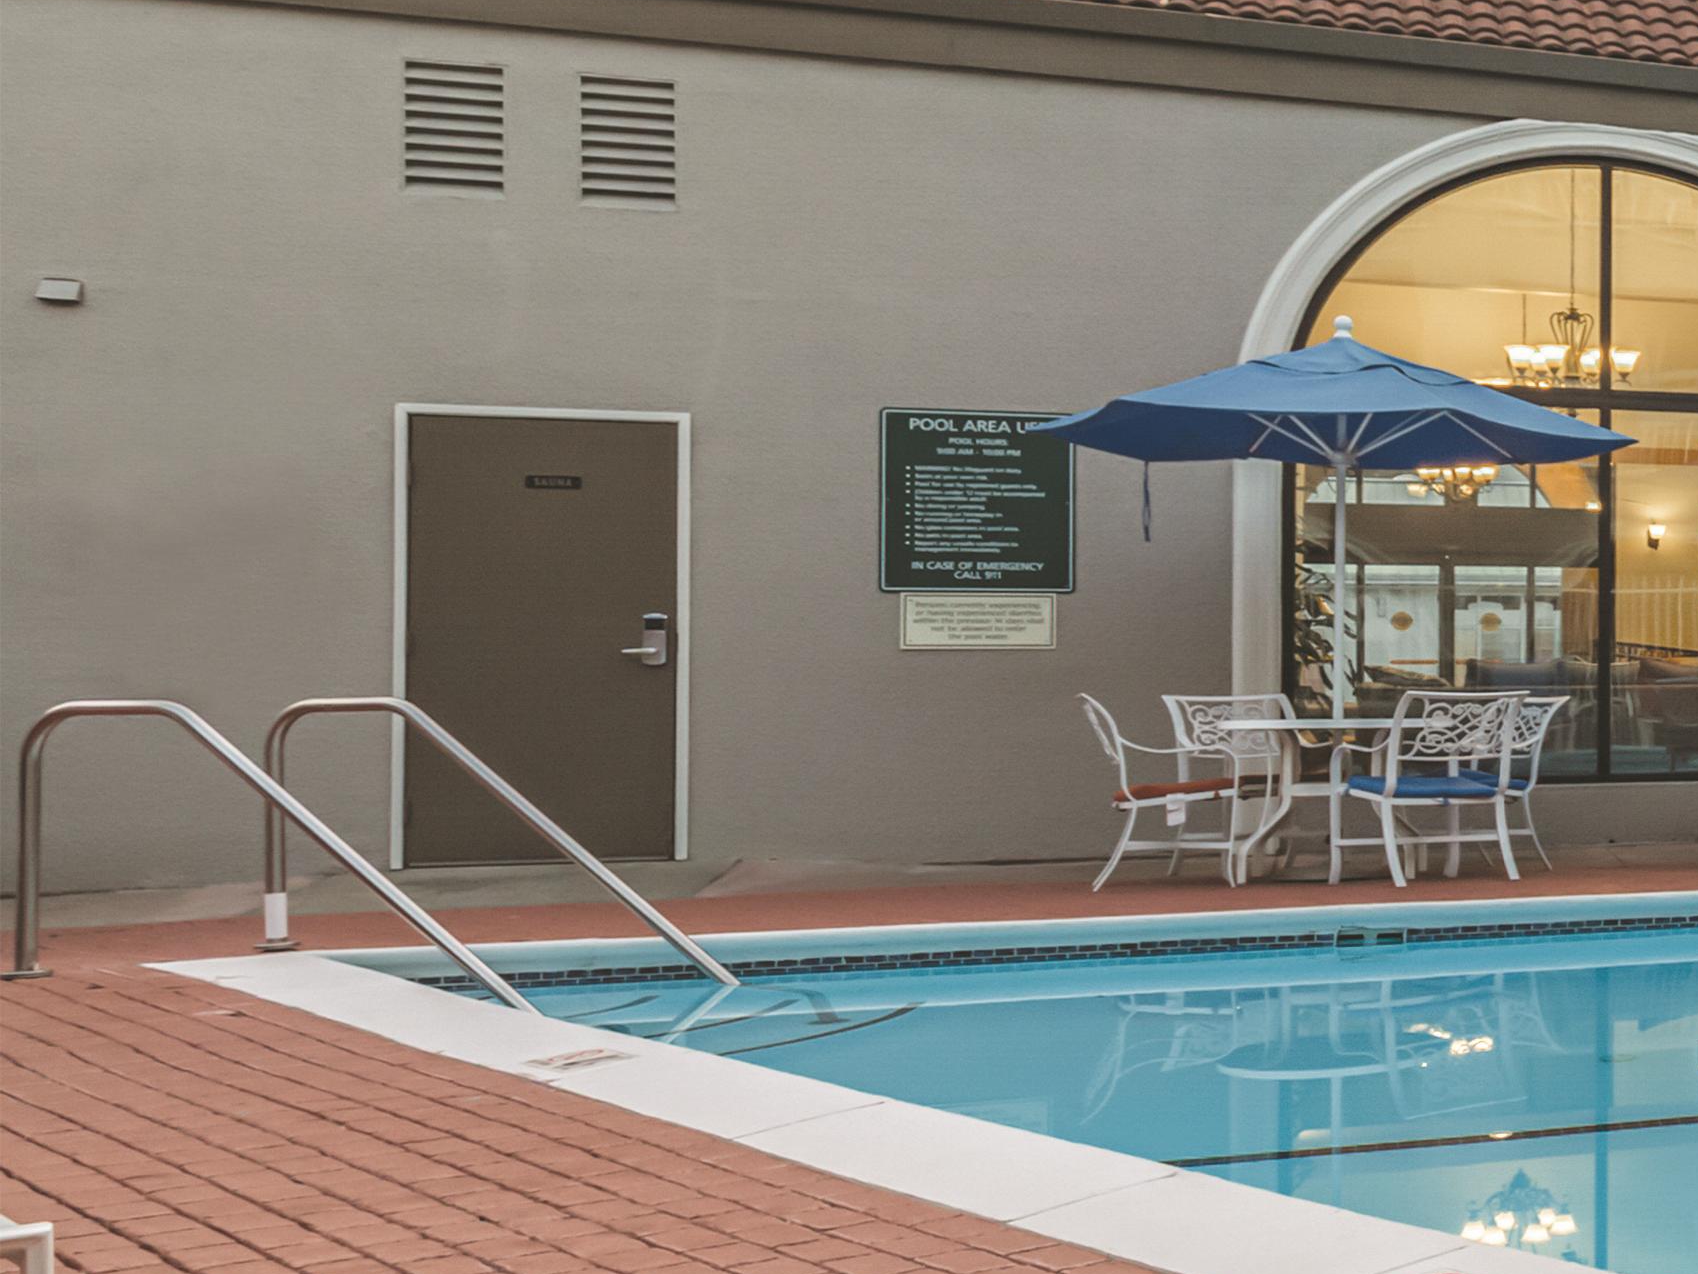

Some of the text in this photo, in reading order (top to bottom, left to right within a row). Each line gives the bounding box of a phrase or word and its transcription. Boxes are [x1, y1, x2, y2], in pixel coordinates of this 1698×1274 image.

[909, 418, 958, 432] POOL
[963, 420, 1012, 433] AREA
[948, 437, 974, 445] POOL
[911, 561, 1045, 571] IN CASE OF EMERGENCY
[953, 571, 982, 580] CALL
